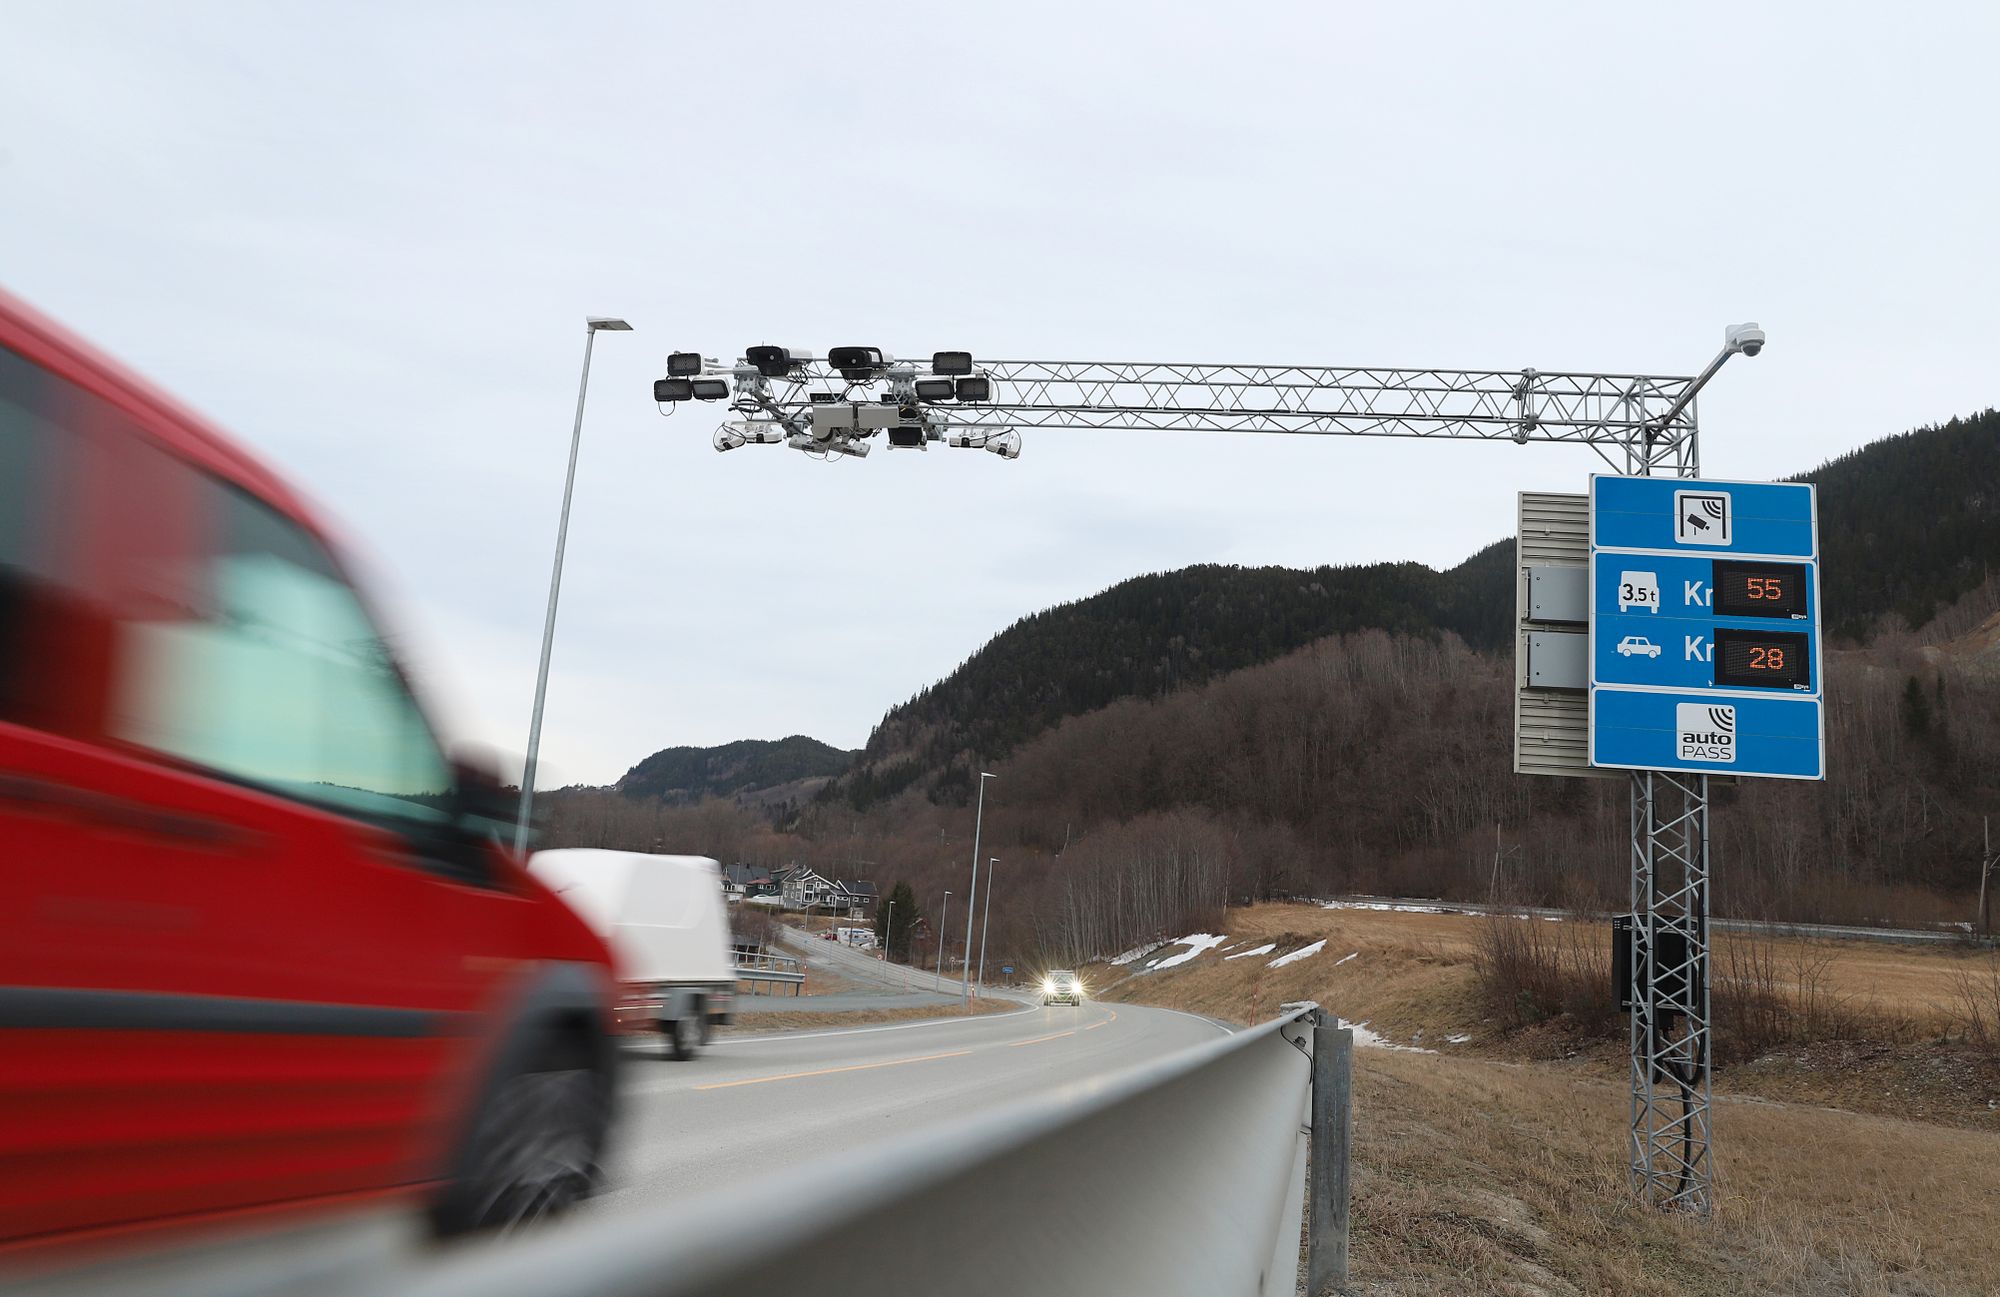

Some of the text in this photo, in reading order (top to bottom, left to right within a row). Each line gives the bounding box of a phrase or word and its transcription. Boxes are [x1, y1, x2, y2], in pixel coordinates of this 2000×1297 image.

[1684, 580, 1713, 607] Kr
[1747, 577, 1781, 600] 55
[1685, 635, 1715, 662] Kr
[1749, 647, 1785, 670] 28
[1683, 732, 1731, 745] auto
[1683, 745, 1731, 760] PASS
